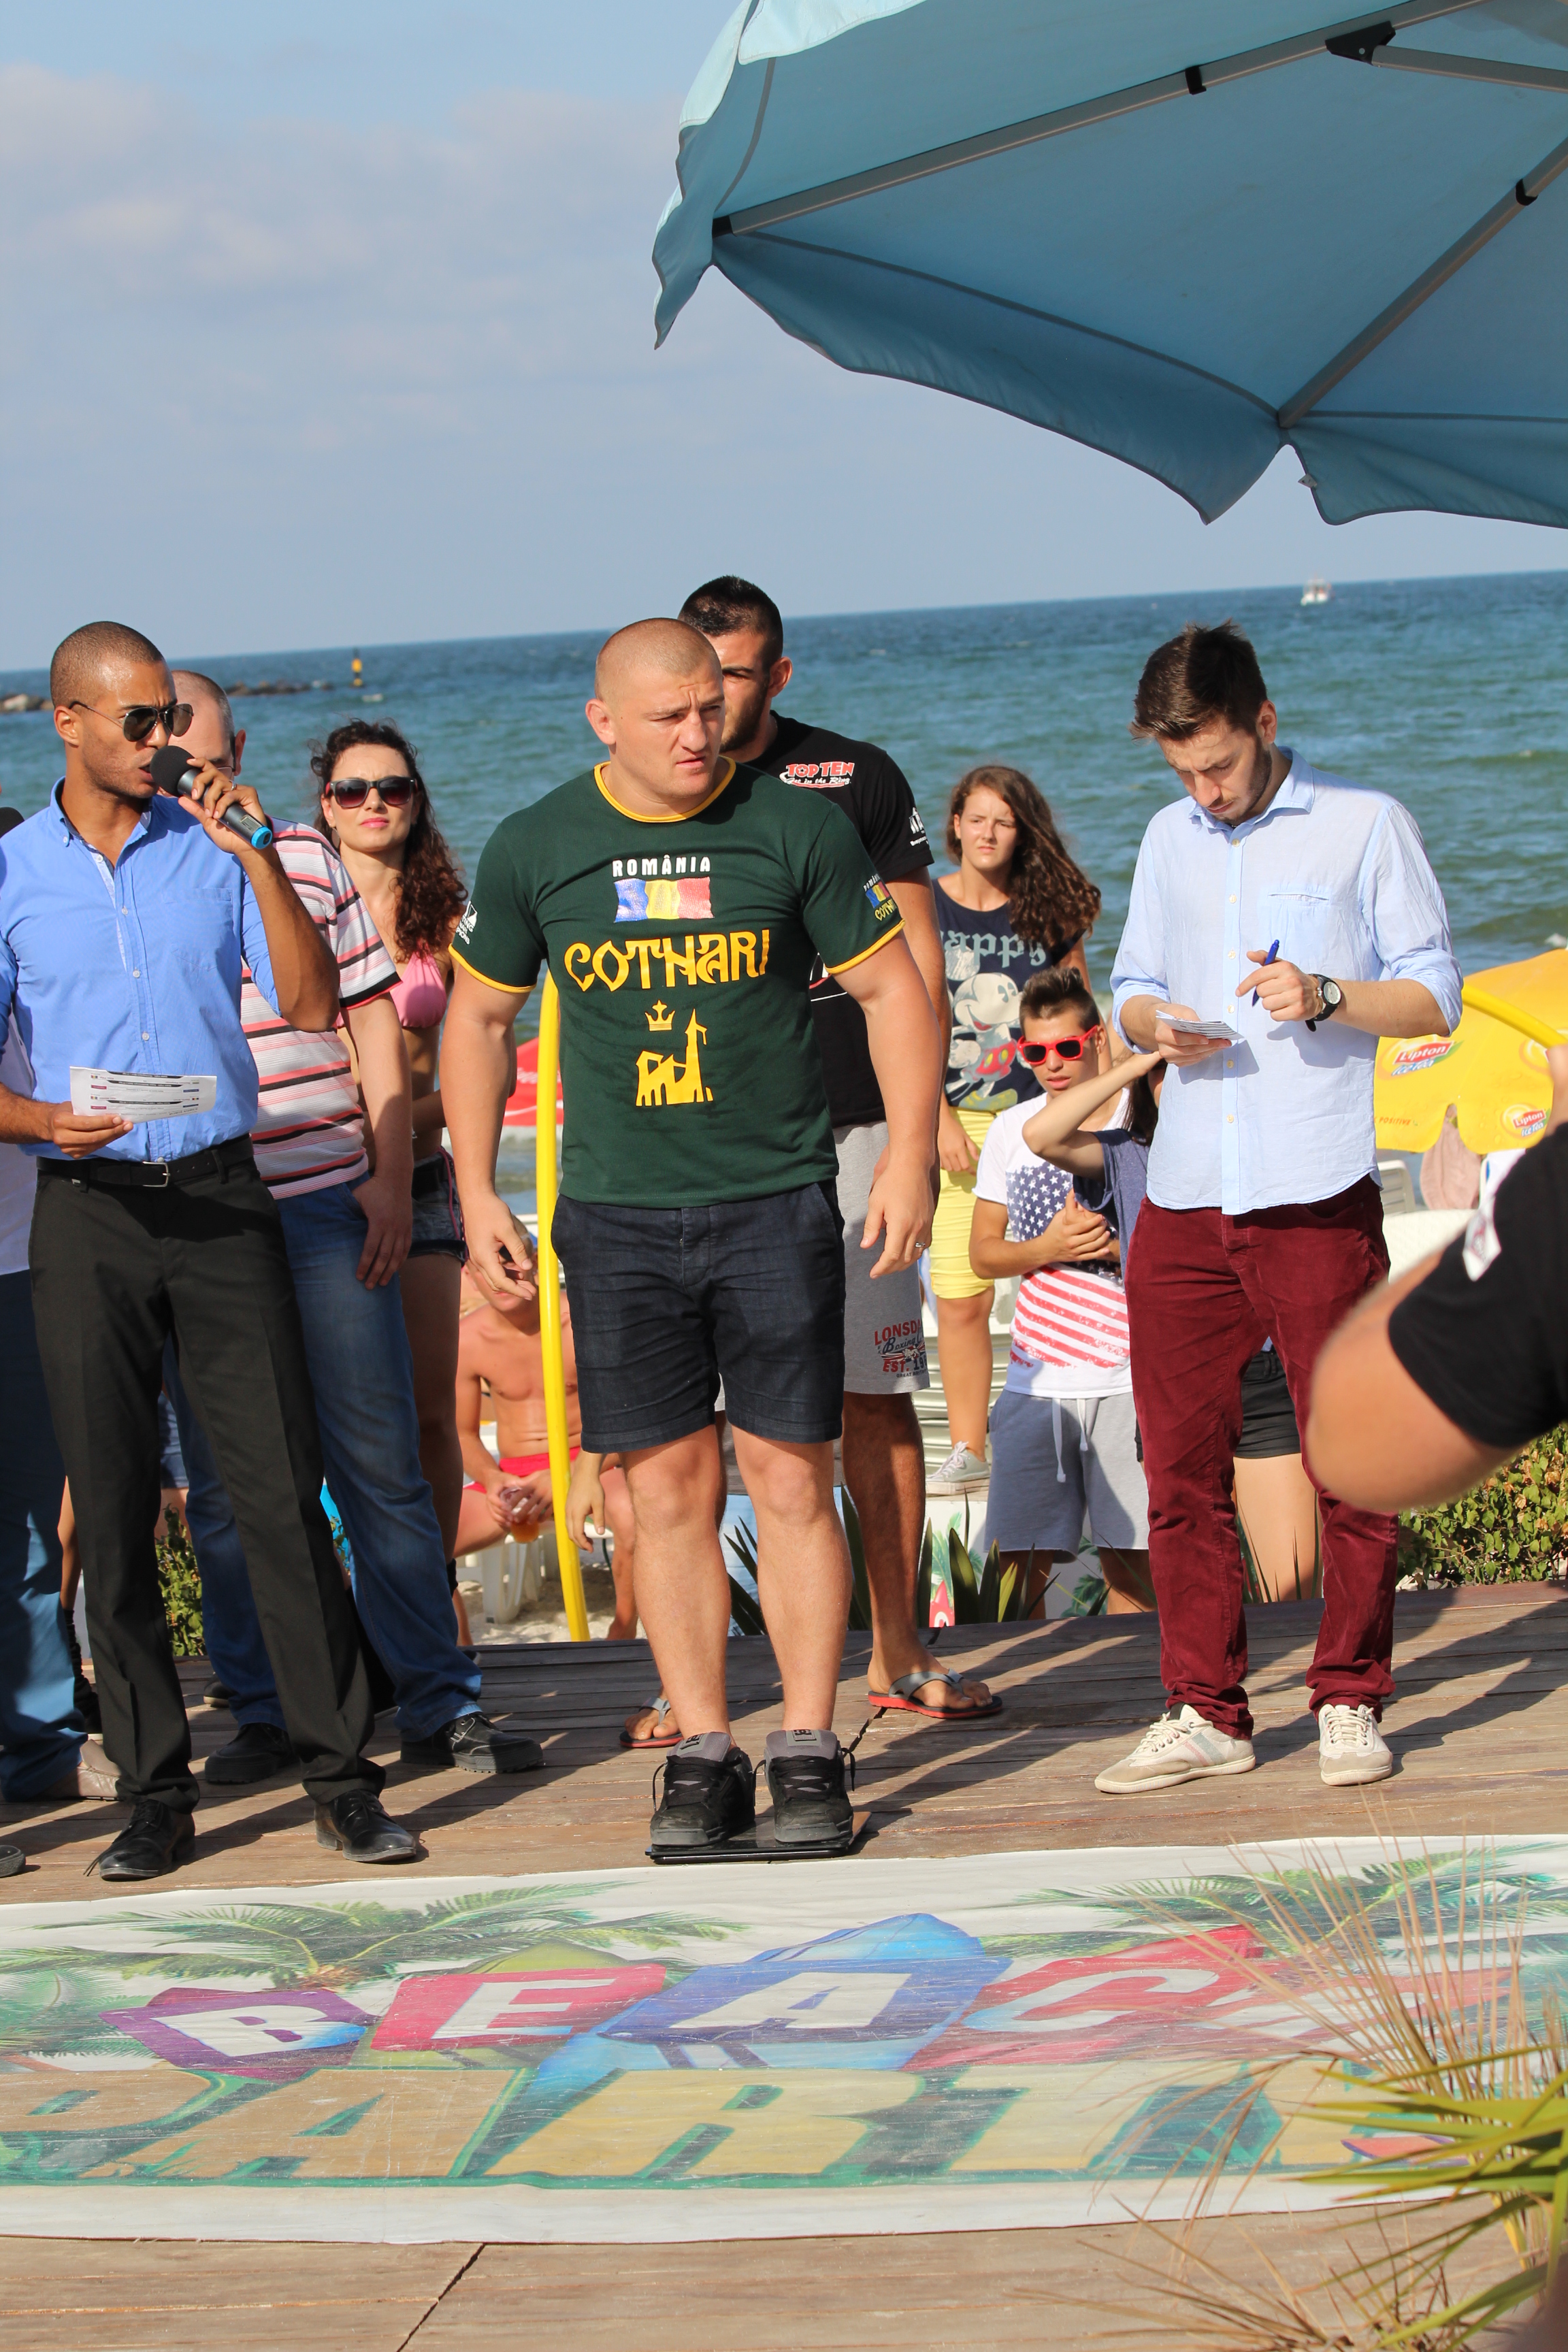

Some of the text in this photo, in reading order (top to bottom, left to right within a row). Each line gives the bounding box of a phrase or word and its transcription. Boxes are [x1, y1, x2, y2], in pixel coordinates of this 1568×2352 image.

[786, 762, 855, 777] TOP TEN
[612, 854, 711, 877] ROMÂNIA
[1399, 1045, 1446, 1061] Lipton
[1379, 1117, 1411, 1125] POSITIVE
[1515, 1112, 1543, 1126] Lipton
[883, 1337, 916, 1354] Boxing
[883, 1360, 909, 1373] EST.
